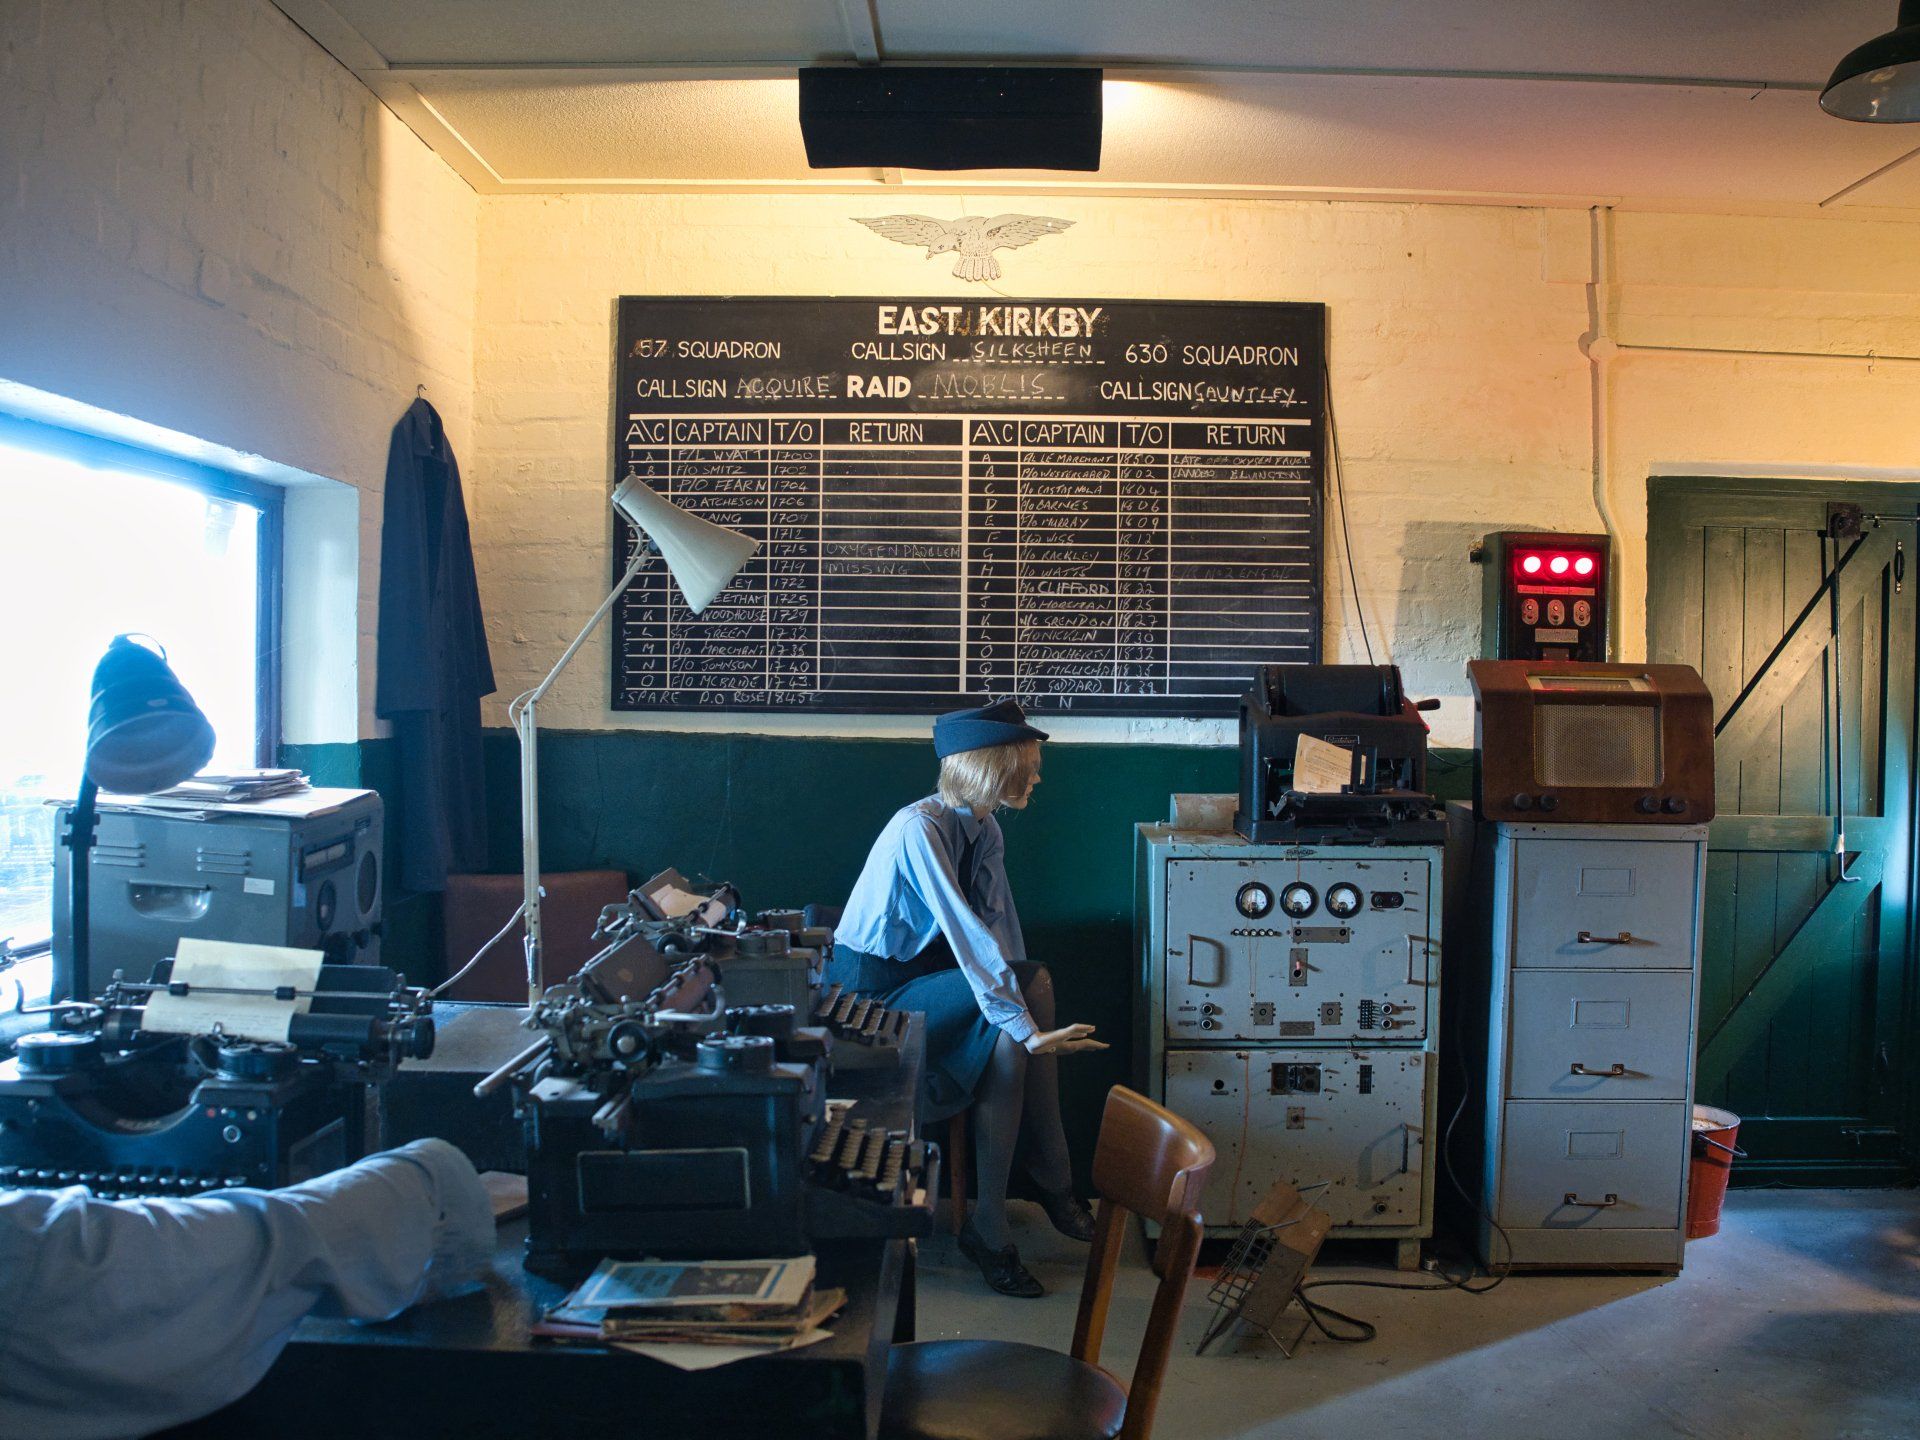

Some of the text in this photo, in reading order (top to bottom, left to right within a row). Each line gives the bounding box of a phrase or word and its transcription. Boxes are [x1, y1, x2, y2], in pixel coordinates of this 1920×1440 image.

[878, 306, 1103, 337] EAST KIRKBY
[639, 340, 781, 360] 57 SQUADRON
[852, 342, 1092, 361] CALLSIGN SILKSHEEN
[1125, 344, 1299, 367] 630 SQUADRON
[637, 375, 831, 399] CALLSIGN ACQUIRE
[847, 375, 912, 398] RAID
[1100, 381, 1192, 400] CALLSIGN
[675, 422, 762, 443] CAPTAIN
[774, 421, 814, 443] T/O
[849, 422, 924, 443] RETURN
[1024, 424, 1106, 444] CAPTAIN
[1126, 424, 1163, 444] T/O
[1207, 425, 1286, 446] RETURN
[646, 451, 654, 461] A
[713, 450, 763, 461] WYATT
[774, 452, 813, 461] 1700
[982, 453, 991, 462] A
[1120, 453, 1155, 465] 1850
[1173, 455, 1201, 465] LATE
[676, 463, 698, 476] F/O
[774, 465, 809, 475] 1702
[676, 479, 809, 492] P/O FEARN 1704
[984, 482, 995, 494] C
[676, 496, 806, 508] P/O ATCHESON 1706
[986, 498, 997, 511] D
[1036, 499, 1089, 511] BARNES
[772, 513, 808, 524] 1709
[985, 515, 994, 526] E
[1042, 517, 1089, 528] MURRAY
[774, 529, 806, 540] 1712
[987, 531, 1000, 542] F
[1119, 533, 1152, 545] 1812
[774, 544, 808, 556] 1715
[982, 548, 993, 562] G
[1119, 548, 1153, 561] 1815
[828, 561, 909, 575] MISSING
[980, 564, 993, 576] H
[774, 577, 808, 589] 1722
[1037, 580, 1110, 595] CLIFFORD
[711, 594, 767, 607] EETHAM
[774, 595, 809, 606] 1725
[1118, 596, 1155, 611] 1825
[671, 609, 694, 622] F/S
[701, 609, 768, 622] WOODHOUSE
[772, 610, 808, 622] 1729
[641, 627, 653, 638] L
[770, 627, 807, 640] 1732
[642, 642, 655, 654] M
[1018, 645, 1039, 660] F/O
[1118, 646, 1155, 661] 1832
[642, 658, 655, 670] N
[671, 657, 695, 671] F/O
[701, 657, 758, 671] JOHNSON
[769, 658, 810, 673] 1740
[671, 674, 694, 688] F/O
[627, 690, 681, 705] SPARE
[1059, 697, 1073, 710] N
